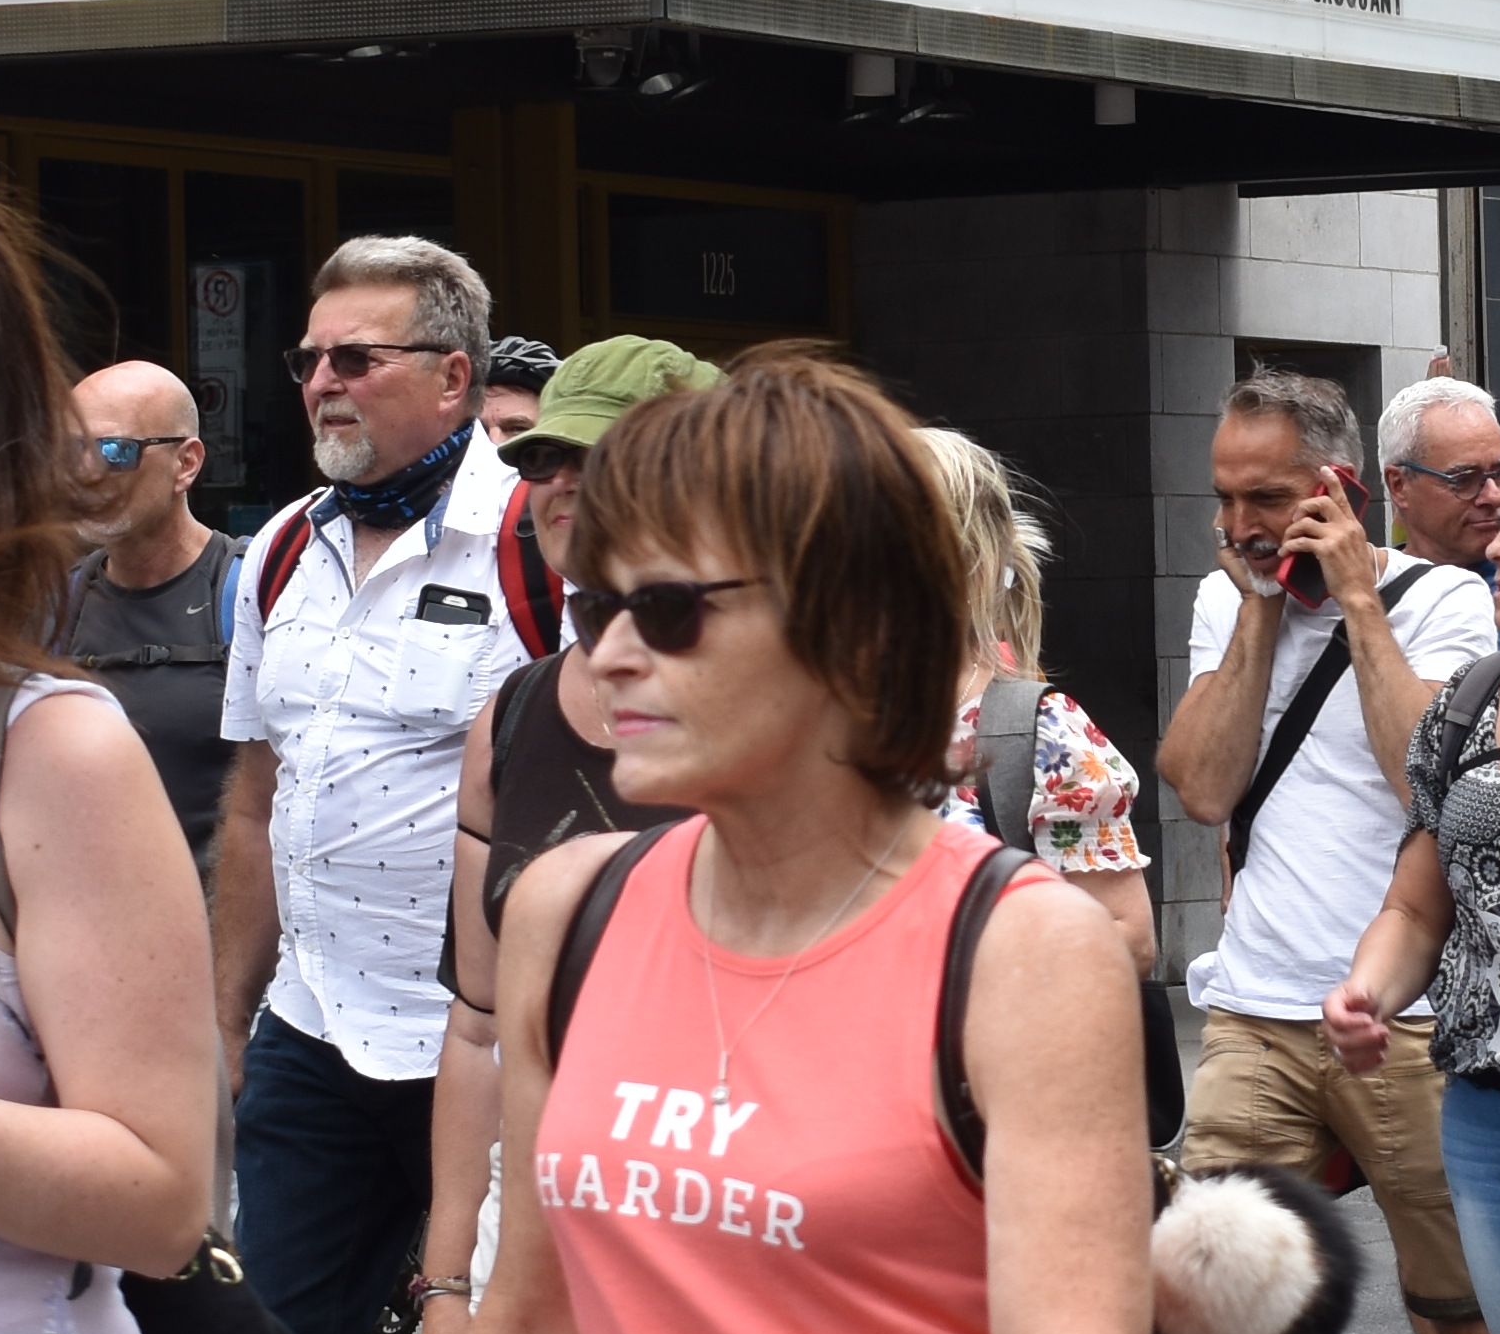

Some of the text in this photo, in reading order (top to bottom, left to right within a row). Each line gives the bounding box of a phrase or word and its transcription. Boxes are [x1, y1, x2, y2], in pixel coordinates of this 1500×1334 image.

[703, 252, 735, 295] 1225
[610, 1081, 759, 1157] TRY
[536, 1152, 806, 1250] HARDER
